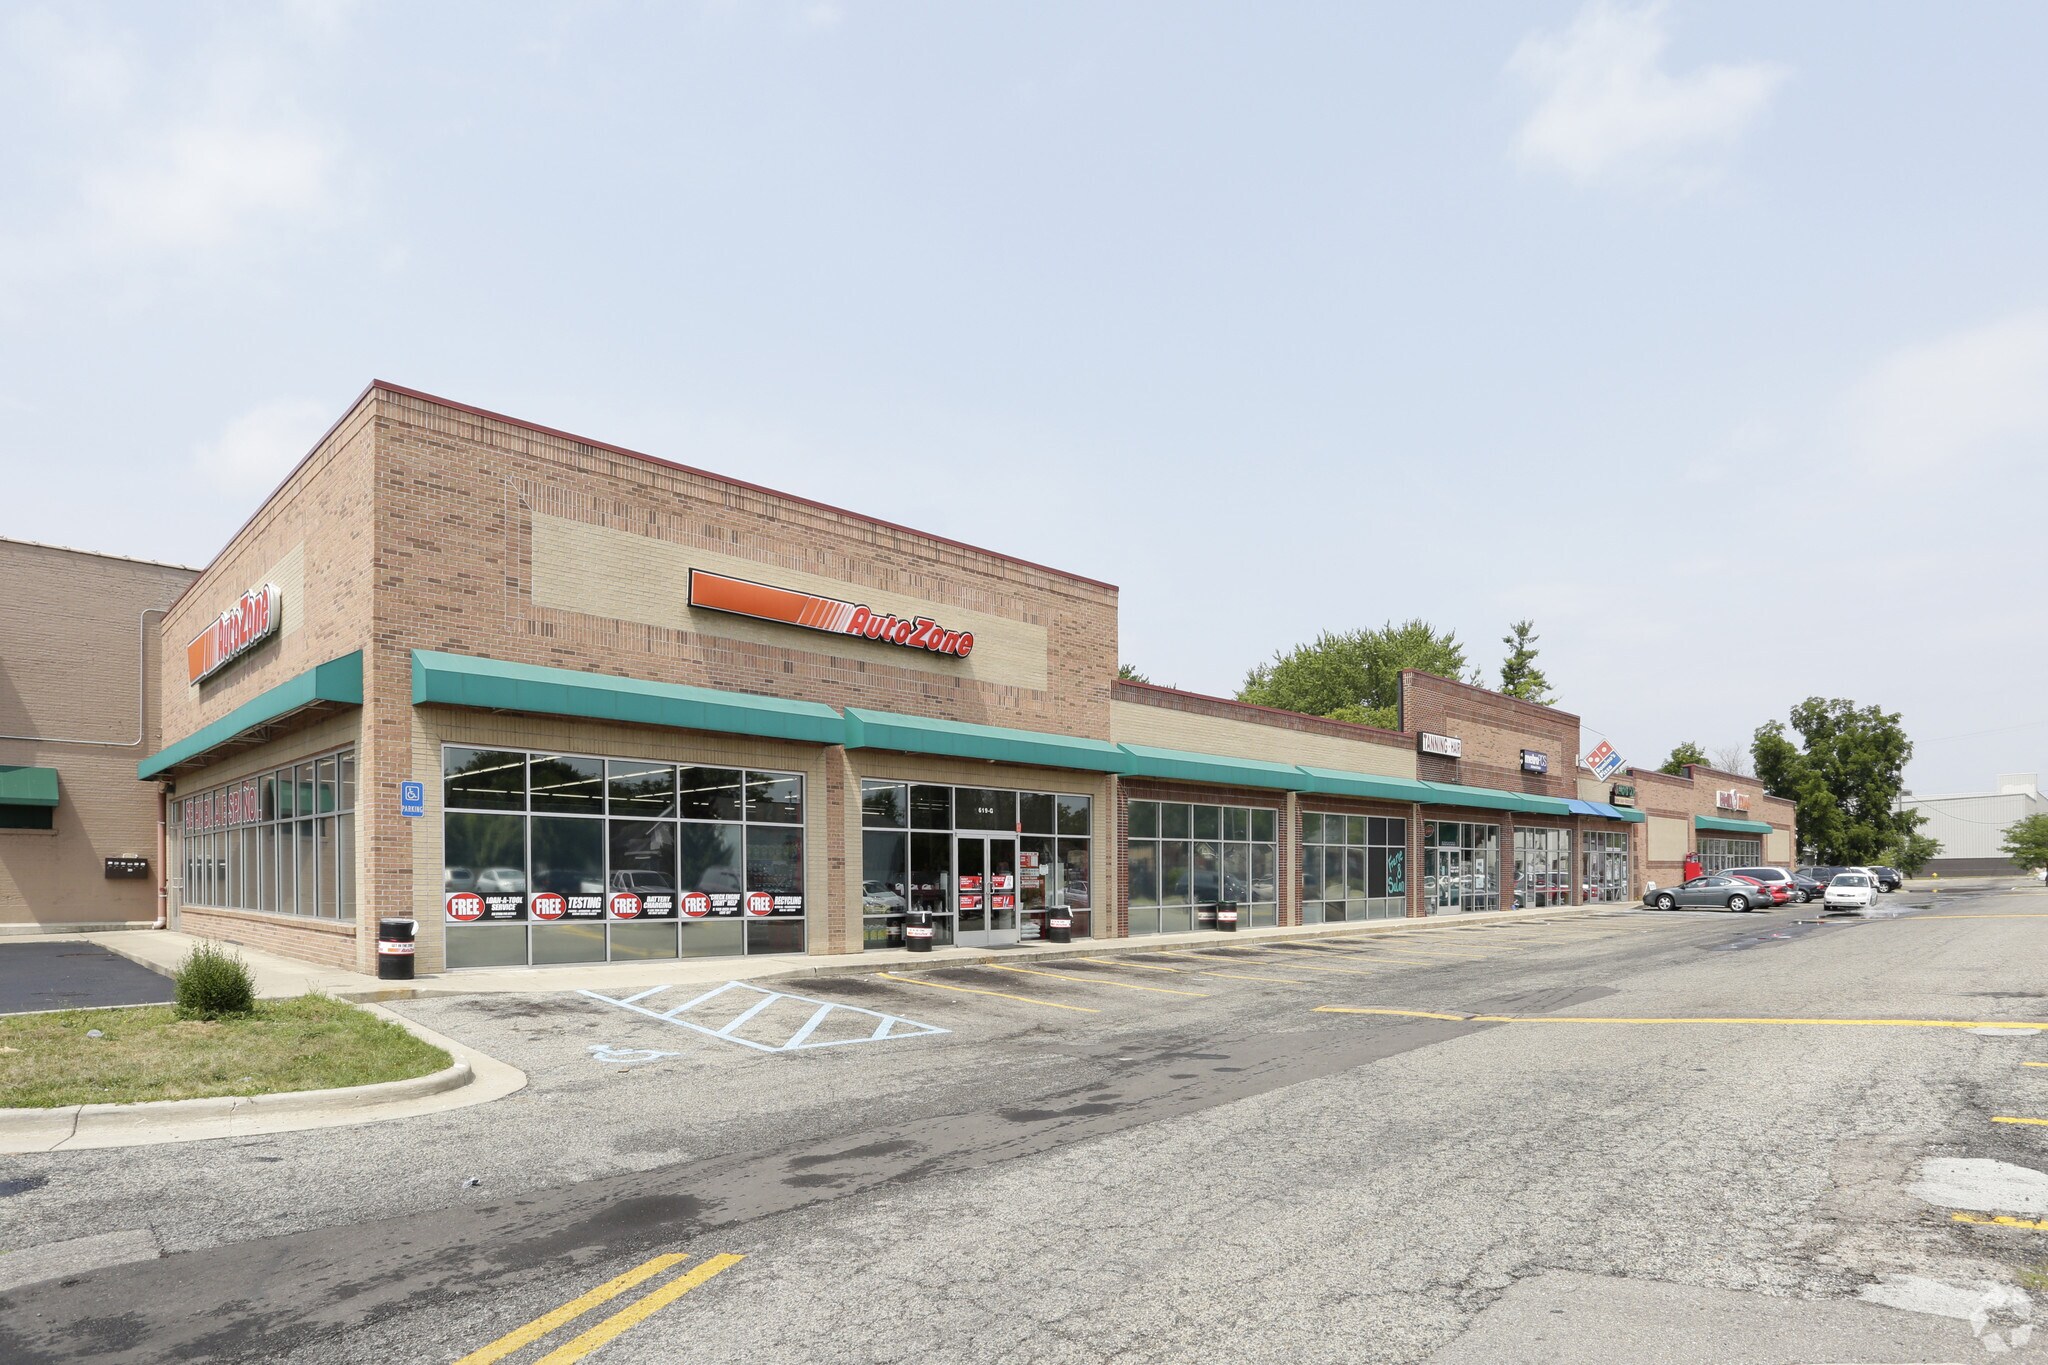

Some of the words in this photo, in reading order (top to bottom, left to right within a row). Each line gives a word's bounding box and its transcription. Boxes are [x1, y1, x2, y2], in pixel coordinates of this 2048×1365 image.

[217, 586, 270, 662] AutoZone
[847, 605, 974, 659] AutoZone
[1423, 733, 1447, 753] TANNING
[1525, 754, 1547, 767] metroPCS
[1595, 753, 1616, 773] Domino's
[1599, 765, 1613, 778] Pizza
[451, 898, 480, 915] FREE
[486, 896, 523, 904] LOAN-A-TOOL
[536, 898, 562, 915] FREE
[568, 897, 602, 909] TESTING
[614, 898, 638, 913] FREE
[685, 897, 707, 913] FREE
[750, 897, 770, 912] FREE
[774, 896, 802, 905] RECYCLING
